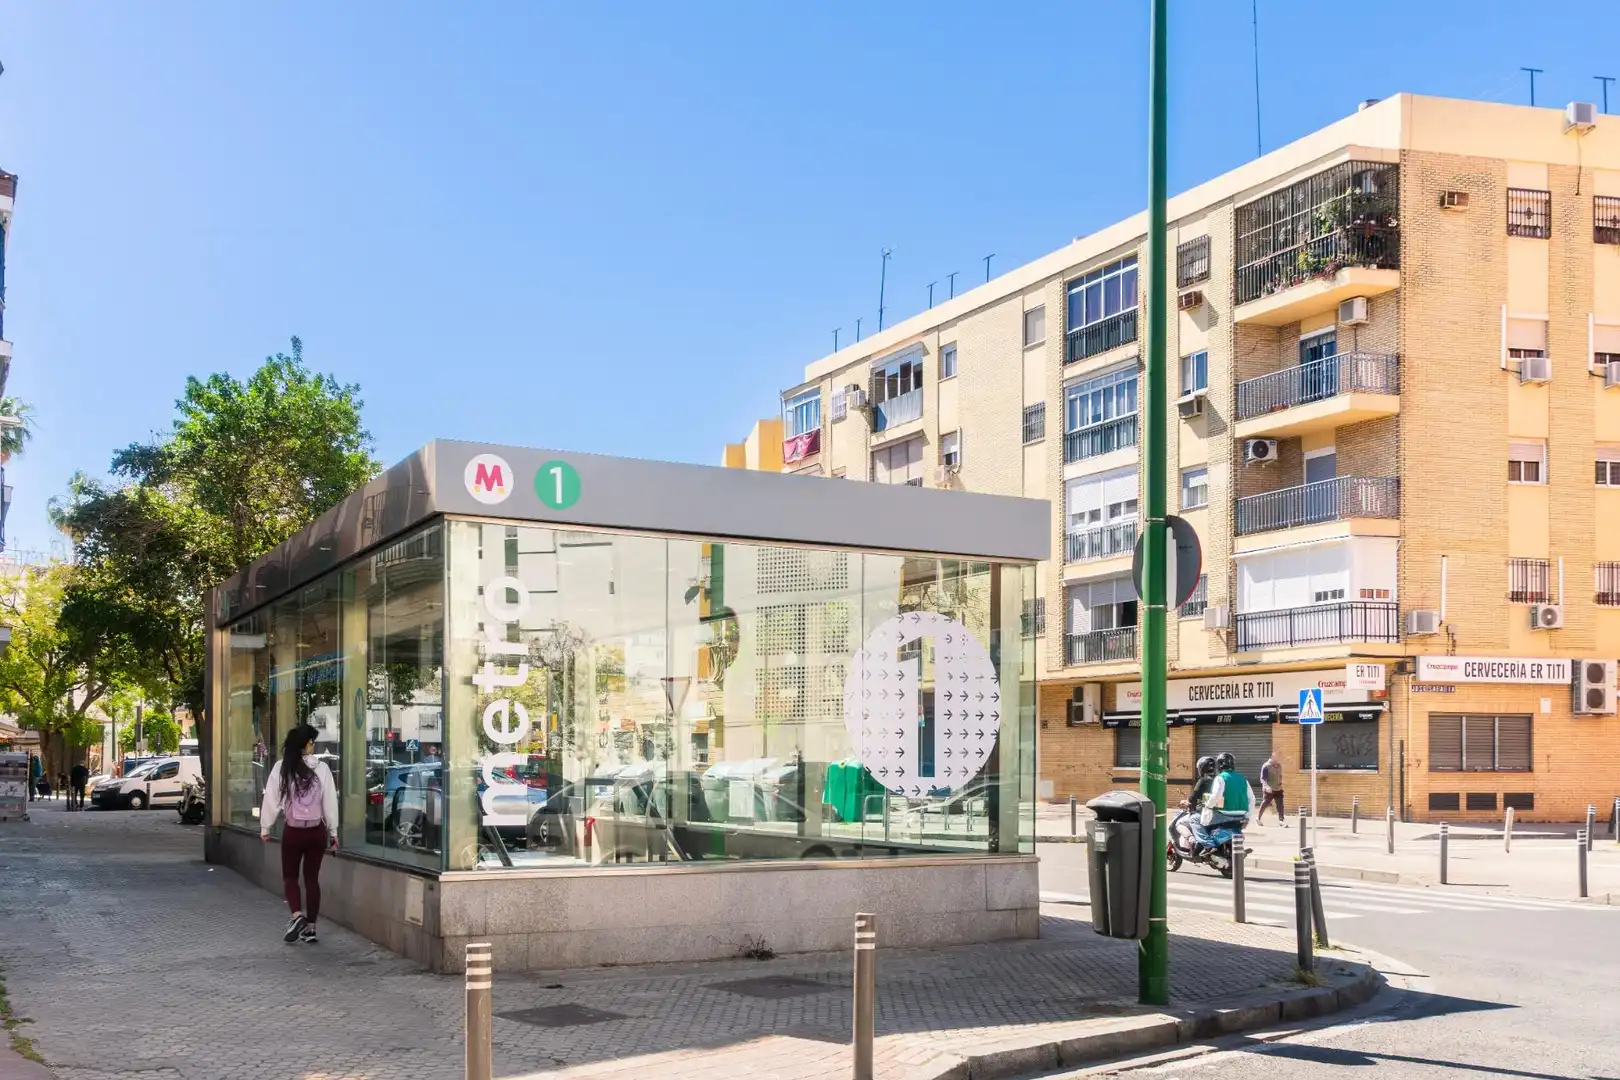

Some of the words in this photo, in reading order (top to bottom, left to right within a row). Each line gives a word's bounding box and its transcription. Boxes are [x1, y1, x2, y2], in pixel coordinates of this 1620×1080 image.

[549, 466, 564, 504] 1
[1356, 665, 1365, 678] ER
[1367, 665, 1380, 678] TITI
[1426, 663, 1458, 671] Cruzcampo
[1464, 660, 1527, 679] CERVECERÍA
[1530, 663, 1543, 679] ER
[1546, 663, 1565, 679] TITI
[1188, 681, 1240, 701] CERVECERÍA
[1243, 682, 1254, 699] ER
[1257, 681, 1274, 698] TITI
[1317, 680, 1346, 689] Cruzcamp
[473, 576, 531, 827] metro
